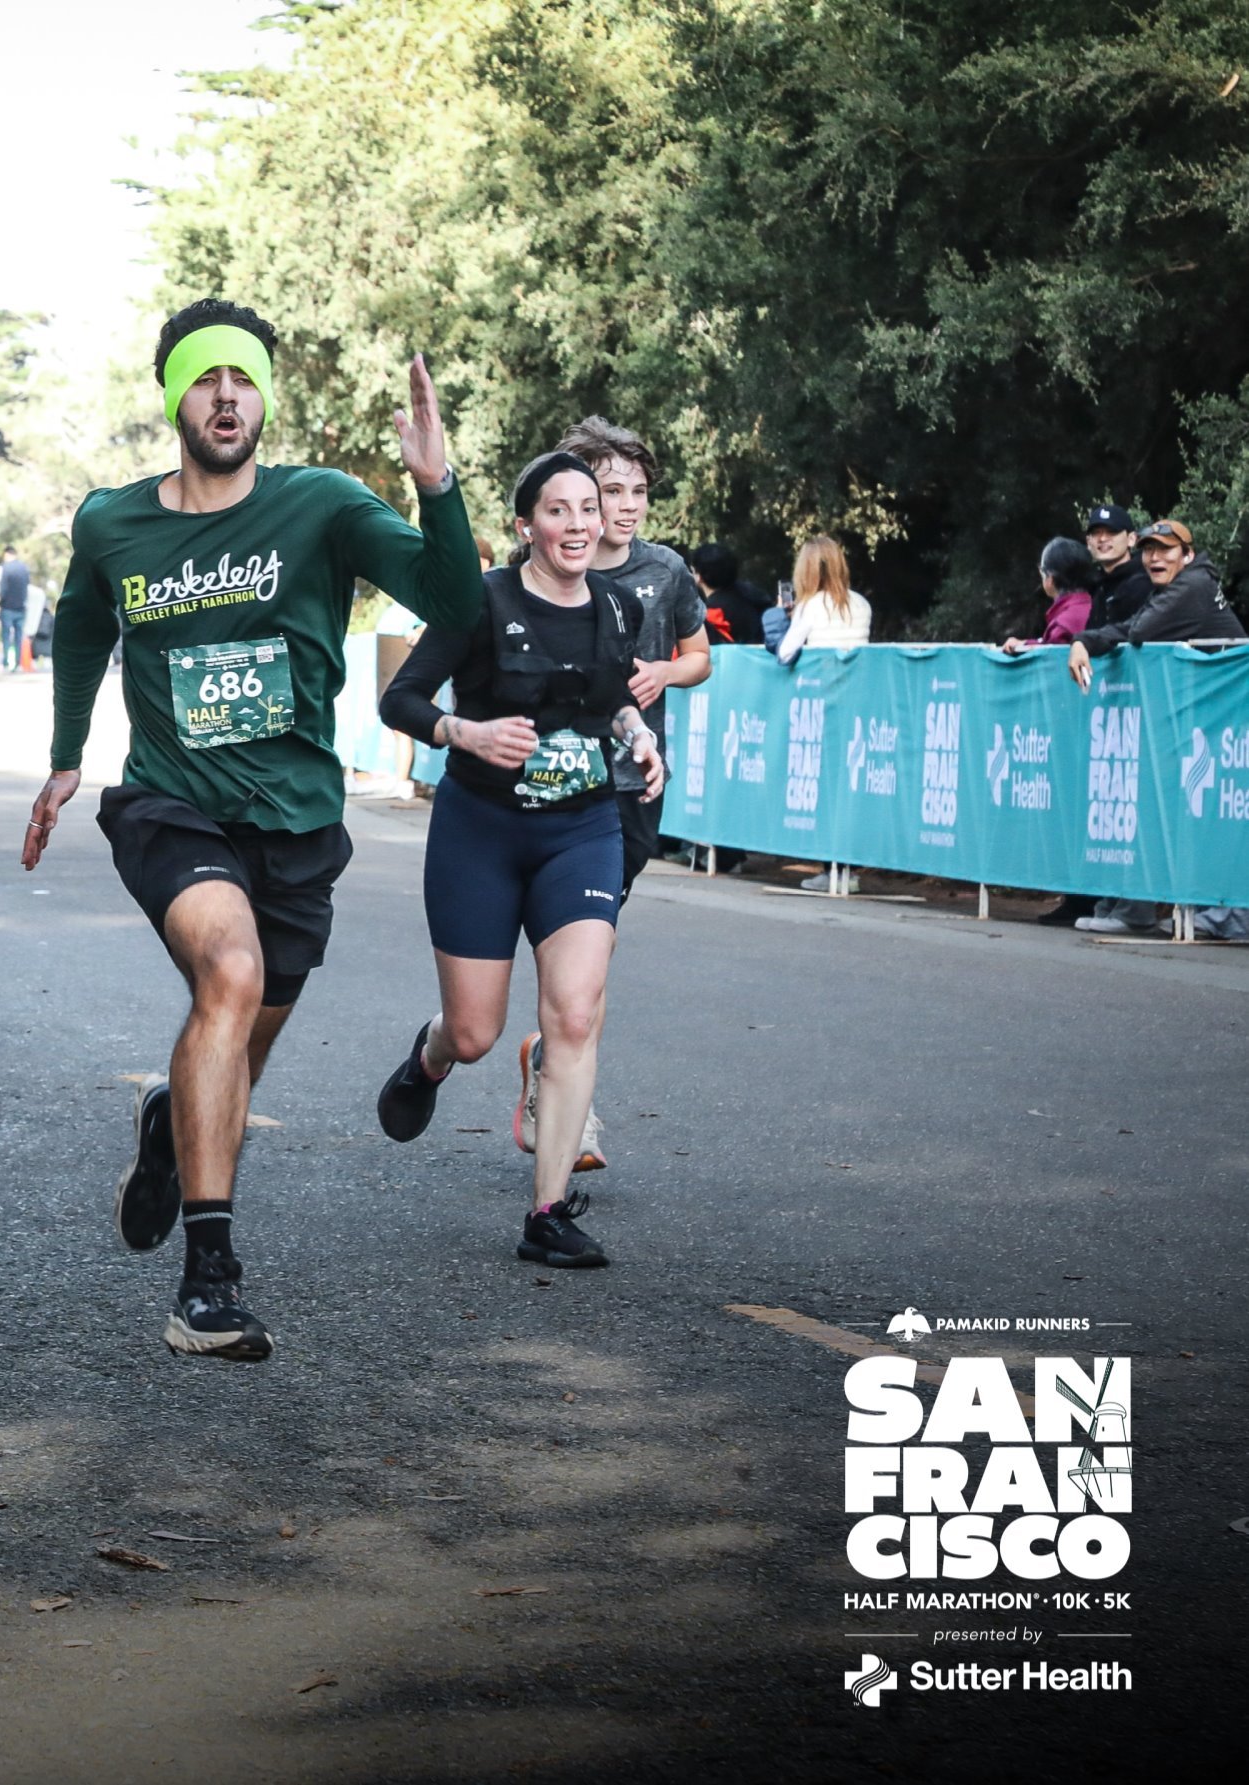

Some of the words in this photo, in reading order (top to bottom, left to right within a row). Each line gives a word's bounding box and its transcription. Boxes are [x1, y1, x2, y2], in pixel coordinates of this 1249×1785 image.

[122, 550, 283, 610] Berkeley
[128, 605, 170, 624] BERKELEY
[173, 601, 199, 616] HALF
[201, 590, 256, 608] MARATHON
[199, 668, 263, 704] 686
[187, 704, 230, 722] HALF
[189, 719, 232, 730] MARATHON
[789, 697, 825, 742] SAN
[925, 702, 961, 750] SAN
[868, 717, 897, 752] Sutter
[1012, 724, 1051, 763] Sutter
[1090, 706, 1141, 759] SAN
[532, 771, 565, 783] HALF
[542, 750, 590, 773] 704
[787, 742, 822, 778] FRAN
[866, 760, 896, 795] Health
[923, 751, 959, 790] FRAN
[786, 776, 819, 812] CISCO
[1011, 771, 1051, 810] Health
[1088, 760, 1139, 802] FRAN
[921, 789, 957, 827] CISCO
[1087, 800, 1137, 843] CISCO
